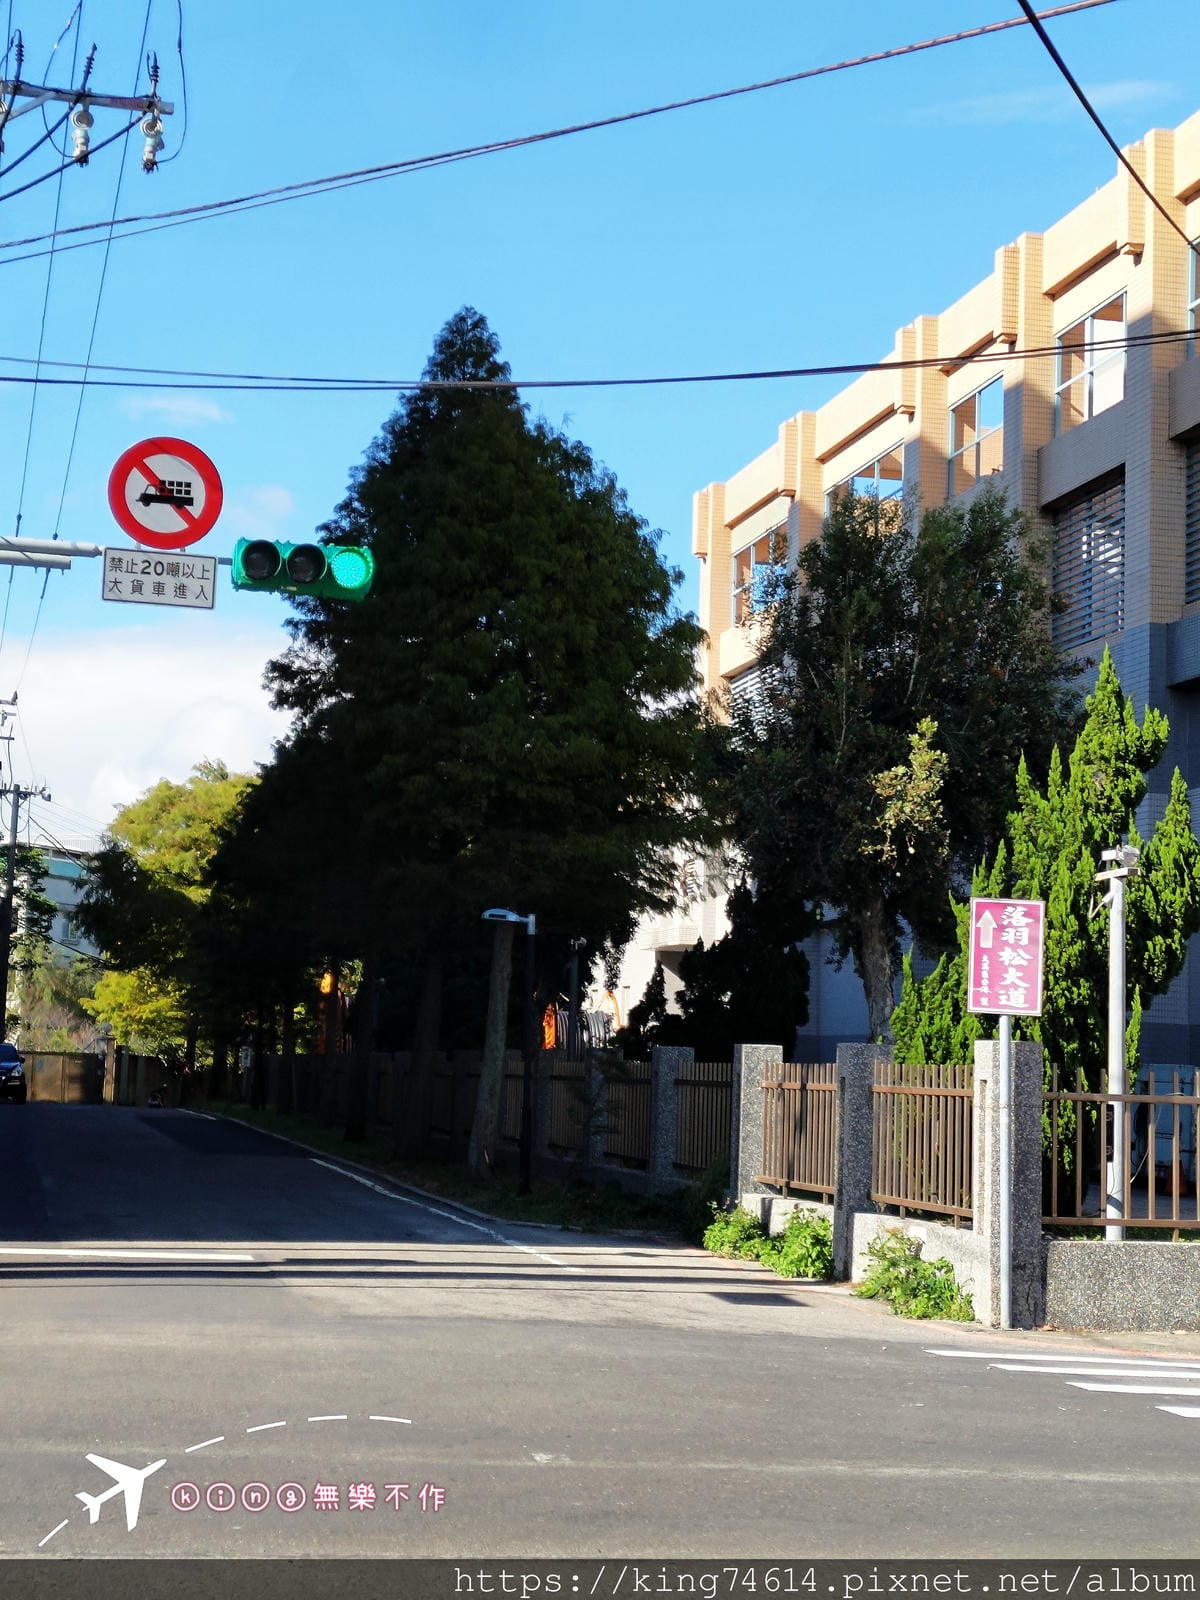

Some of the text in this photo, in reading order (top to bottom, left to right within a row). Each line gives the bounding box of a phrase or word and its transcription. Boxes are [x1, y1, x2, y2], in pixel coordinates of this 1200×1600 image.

[109, 557, 210, 580] 禁止20噸以上
[108, 577, 208, 601] 大貨車進入
[998, 906, 1034, 1008] 落羽松大道
